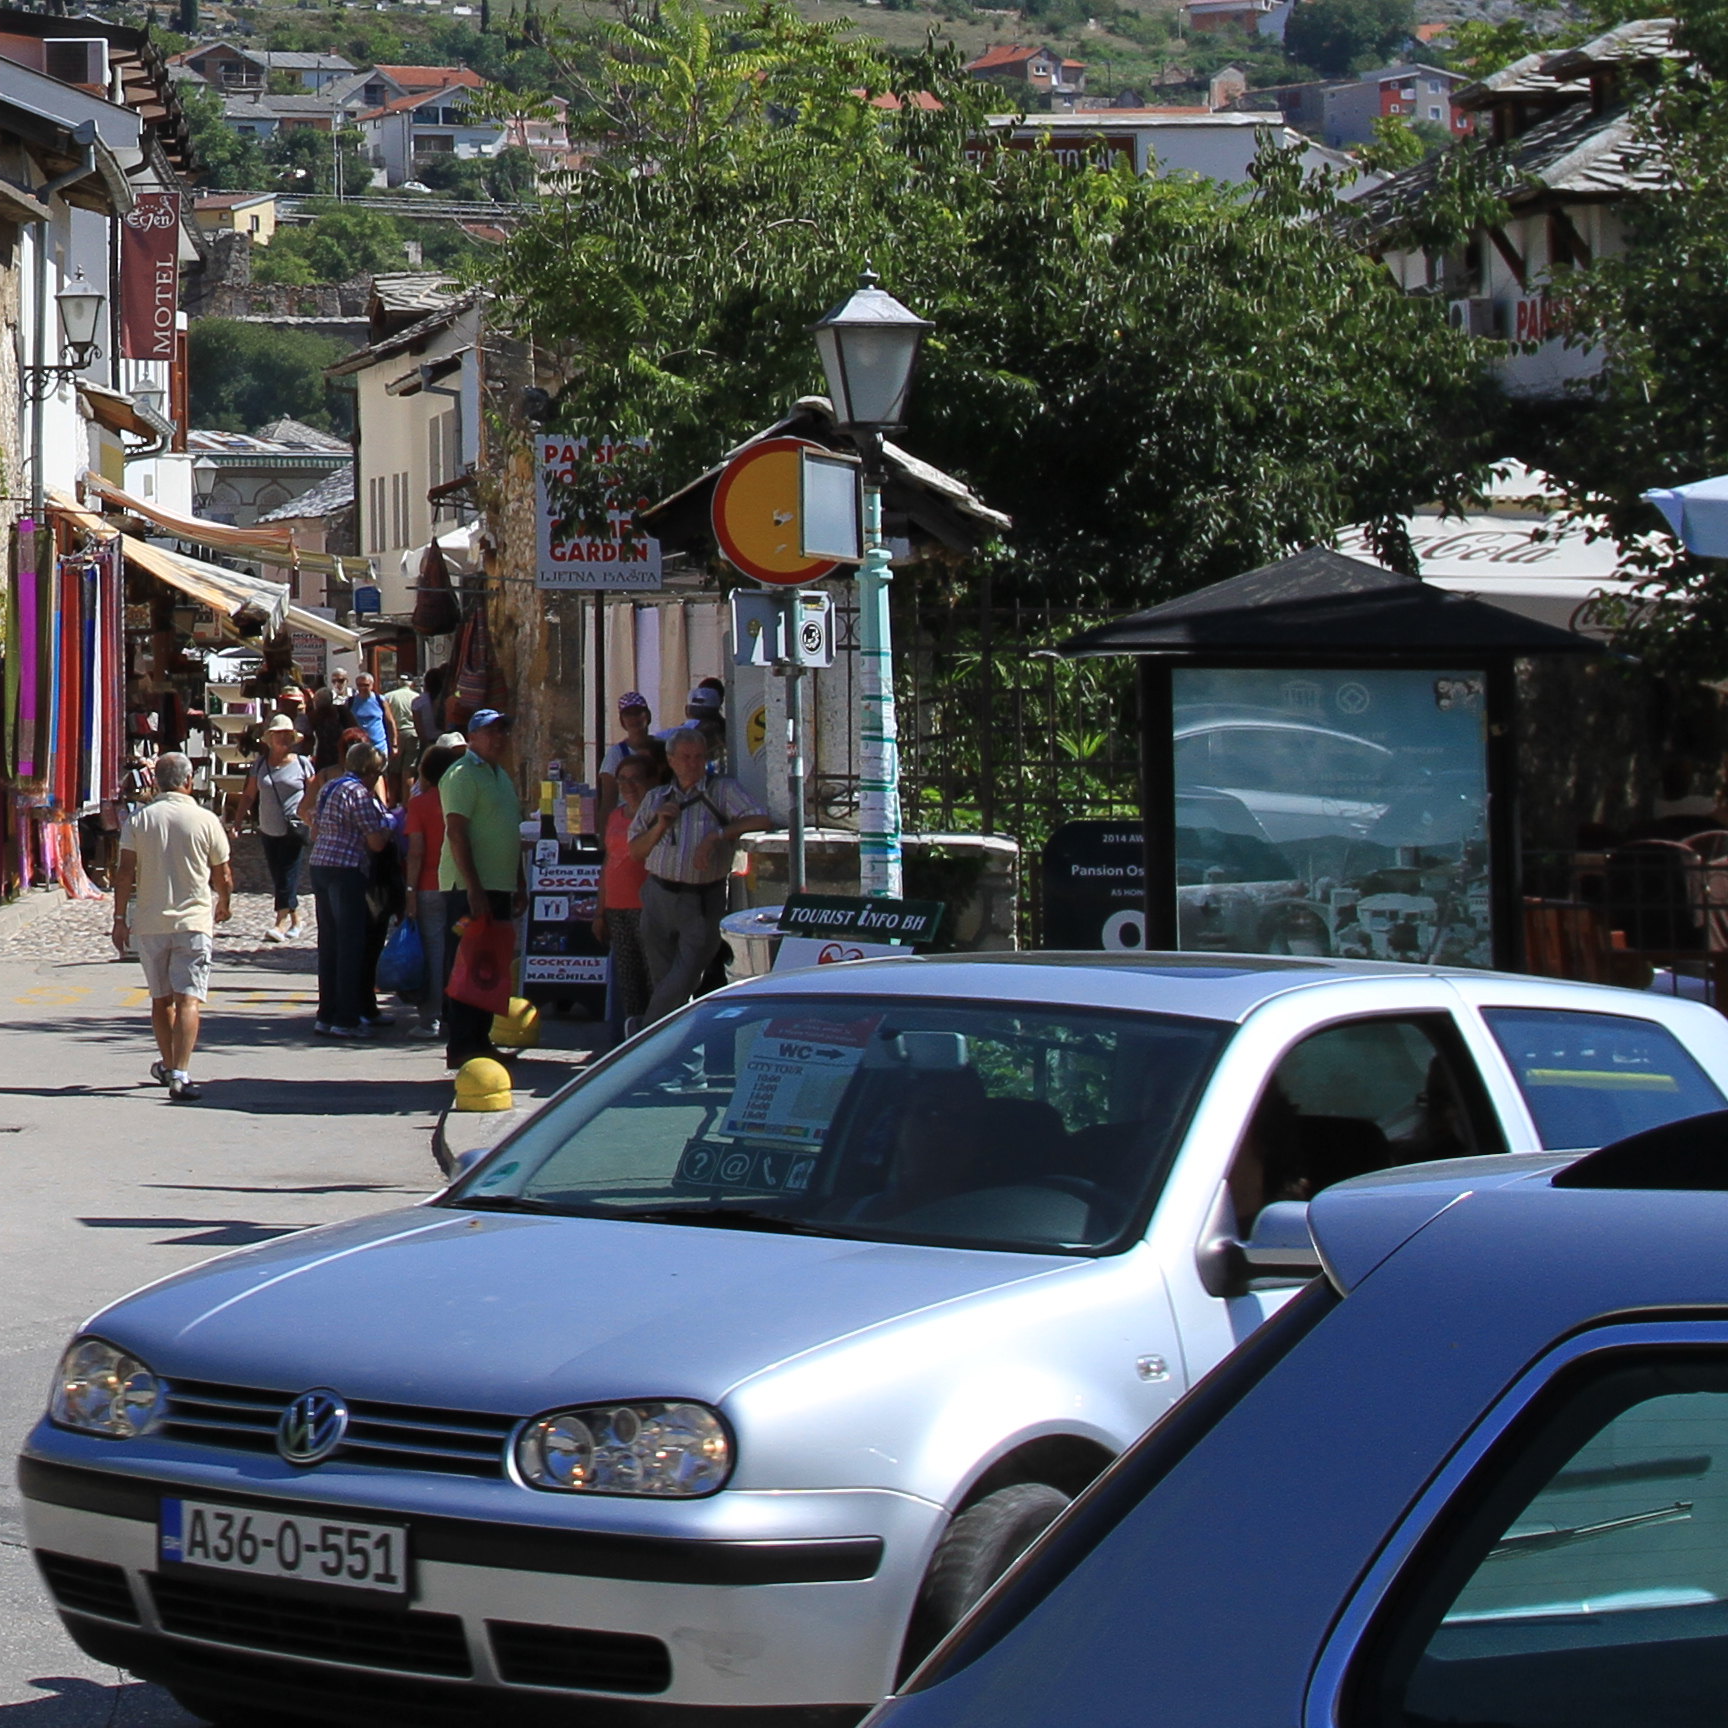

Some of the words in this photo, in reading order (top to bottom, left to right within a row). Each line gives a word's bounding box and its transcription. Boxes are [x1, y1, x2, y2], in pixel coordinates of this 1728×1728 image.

[152, 253, 174, 354] MOTEL
[539, 571, 595, 583] LJETNA
[1102, 834, 1126, 843] 2014
[538, 868, 573, 877] Ljetna
[1071, 864, 1124, 877] Pansion
[790, 907, 856, 926] TOURIST
[901, 915, 927, 931] BH
[527, 958, 601, 967] COCKTAILS
[779, 1043, 814, 1060] WC
[747, 1061, 771, 1072] CITY
[775, 1063, 804, 1075] TOUR
